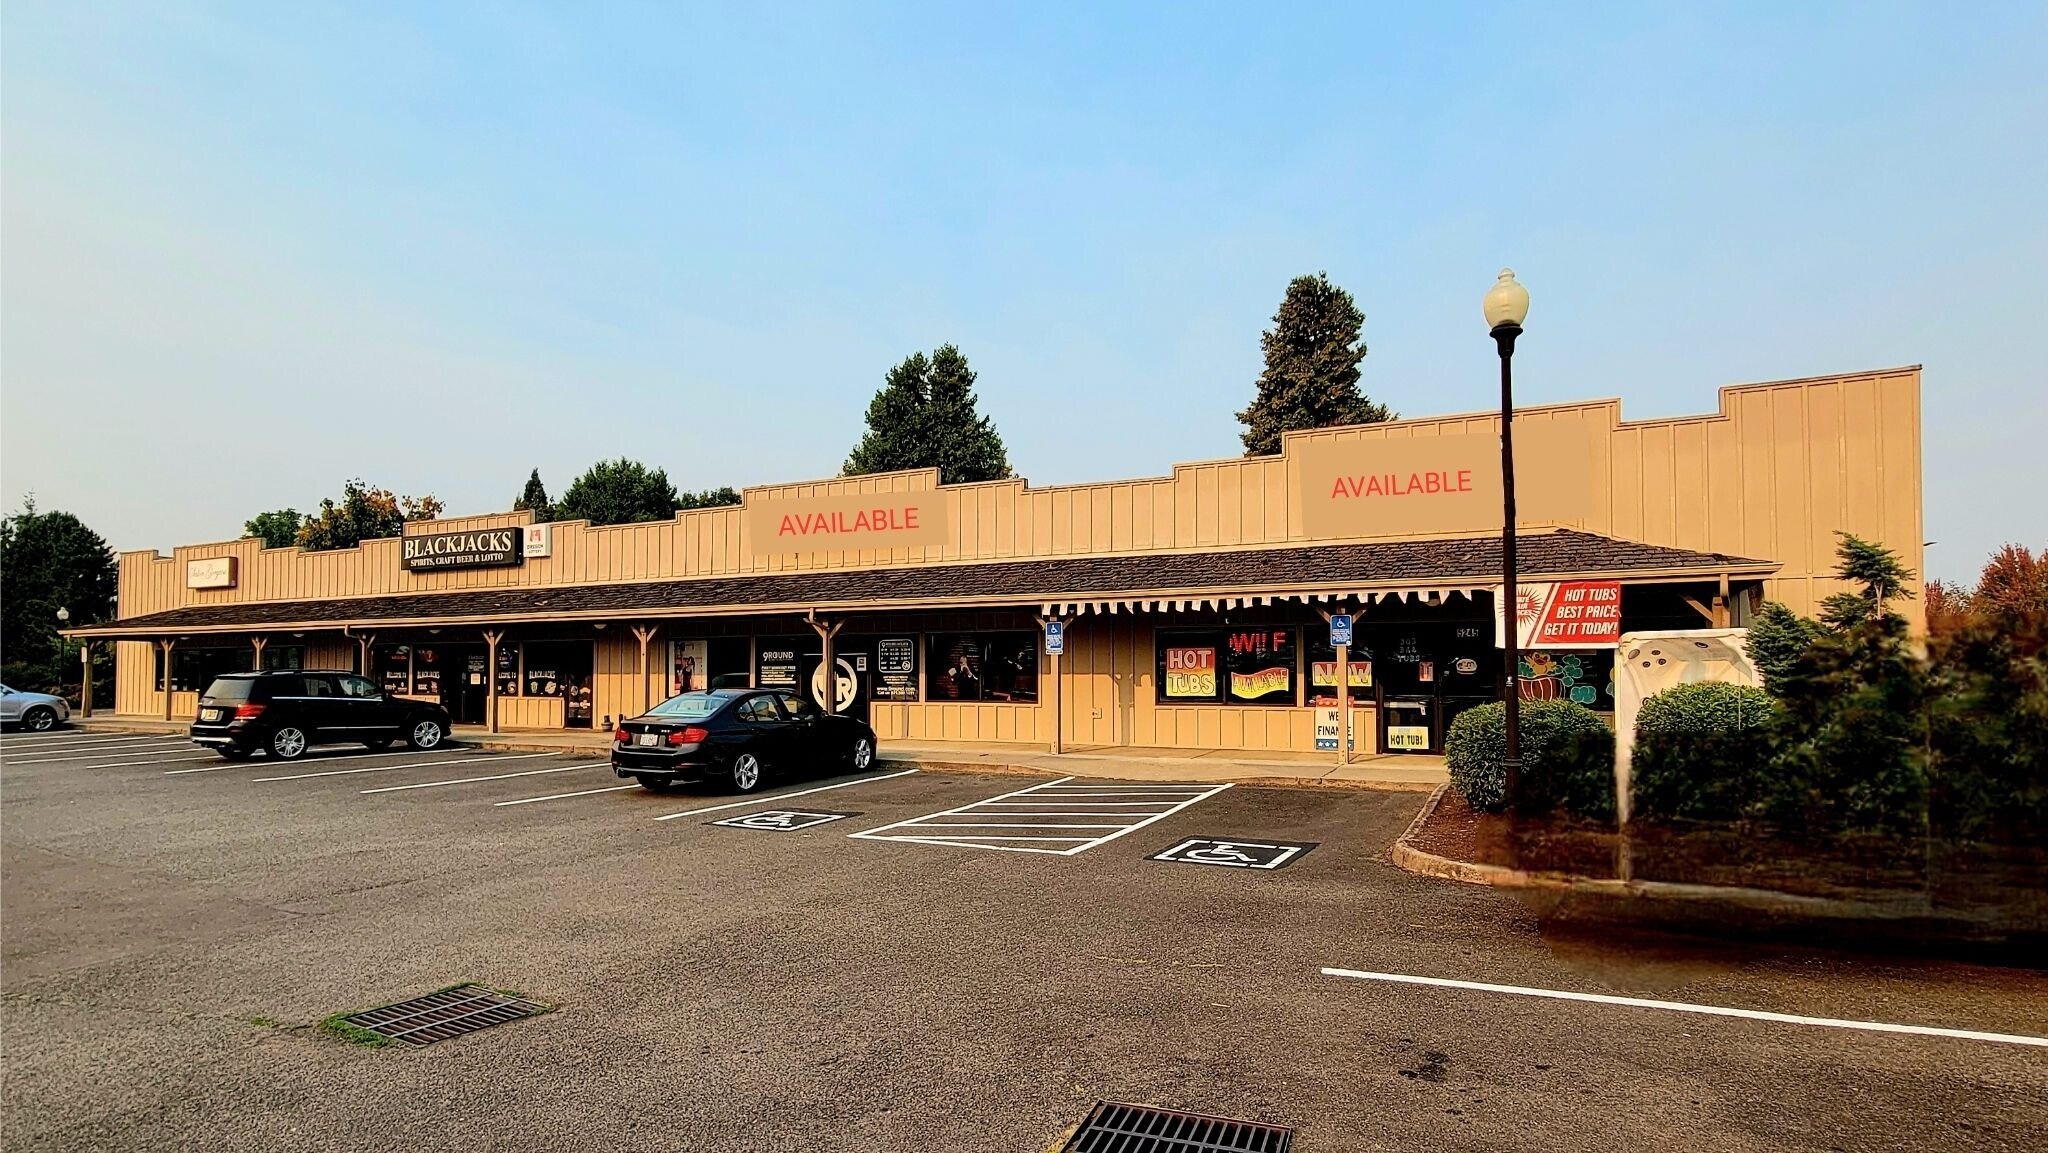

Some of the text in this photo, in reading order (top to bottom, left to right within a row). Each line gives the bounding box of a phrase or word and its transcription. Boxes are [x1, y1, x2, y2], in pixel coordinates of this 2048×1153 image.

[404, 531, 511, 559] BLACKJACKS
[435, 555, 455, 565] CRAFT
[456, 554, 474, 564] BEER
[475, 554, 480, 562] &
[481, 552, 504, 562] LOTTO
[1564, 588, 1617, 602] HOT TUBS
[1556, 605, 1618, 618] BEST PRICE
[1545, 622, 1618, 636] GET IT TODAY!
[763, 651, 794, 661] 9ROUND
[1169, 650, 1212, 669] HOT
[1168, 672, 1215, 694] TUBS
[1233, 669, 1287, 692] AVAILABLE
[1390, 734, 1423, 745] HOT TUBS
